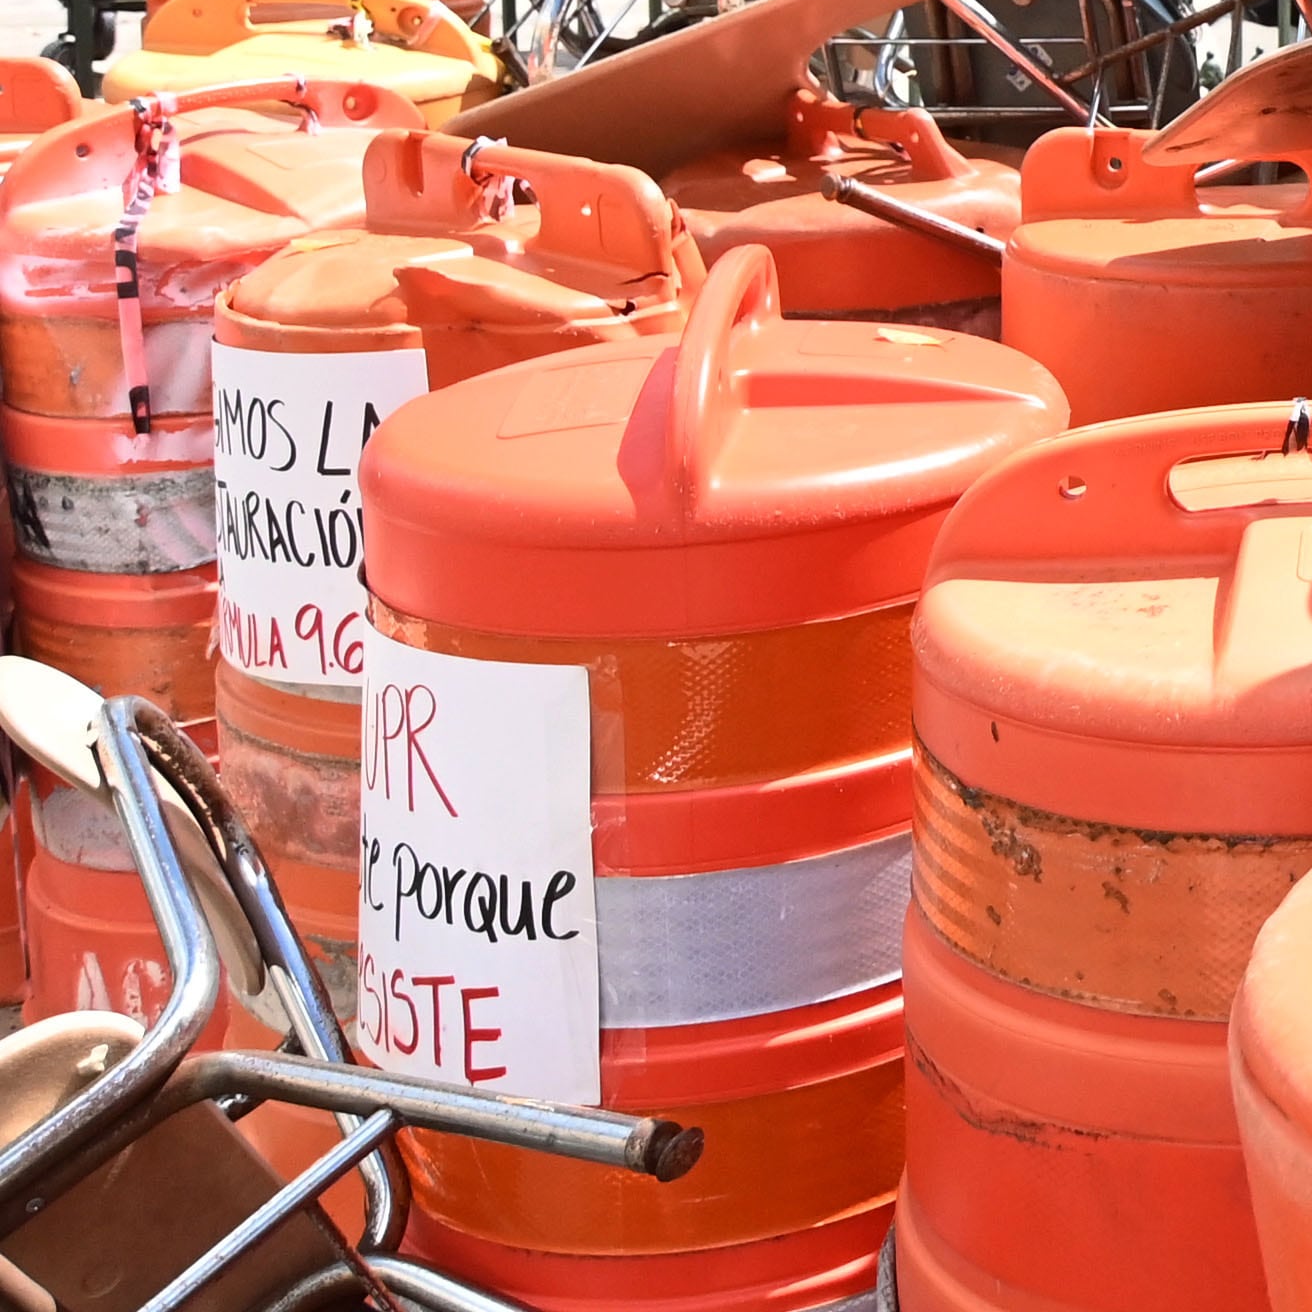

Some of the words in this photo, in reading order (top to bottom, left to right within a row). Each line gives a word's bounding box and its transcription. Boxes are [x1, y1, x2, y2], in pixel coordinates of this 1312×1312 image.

[217, 480, 363, 569] TAURACIÓ
[221, 596, 289, 670] RMULA
[364, 676, 459, 818] UPR
